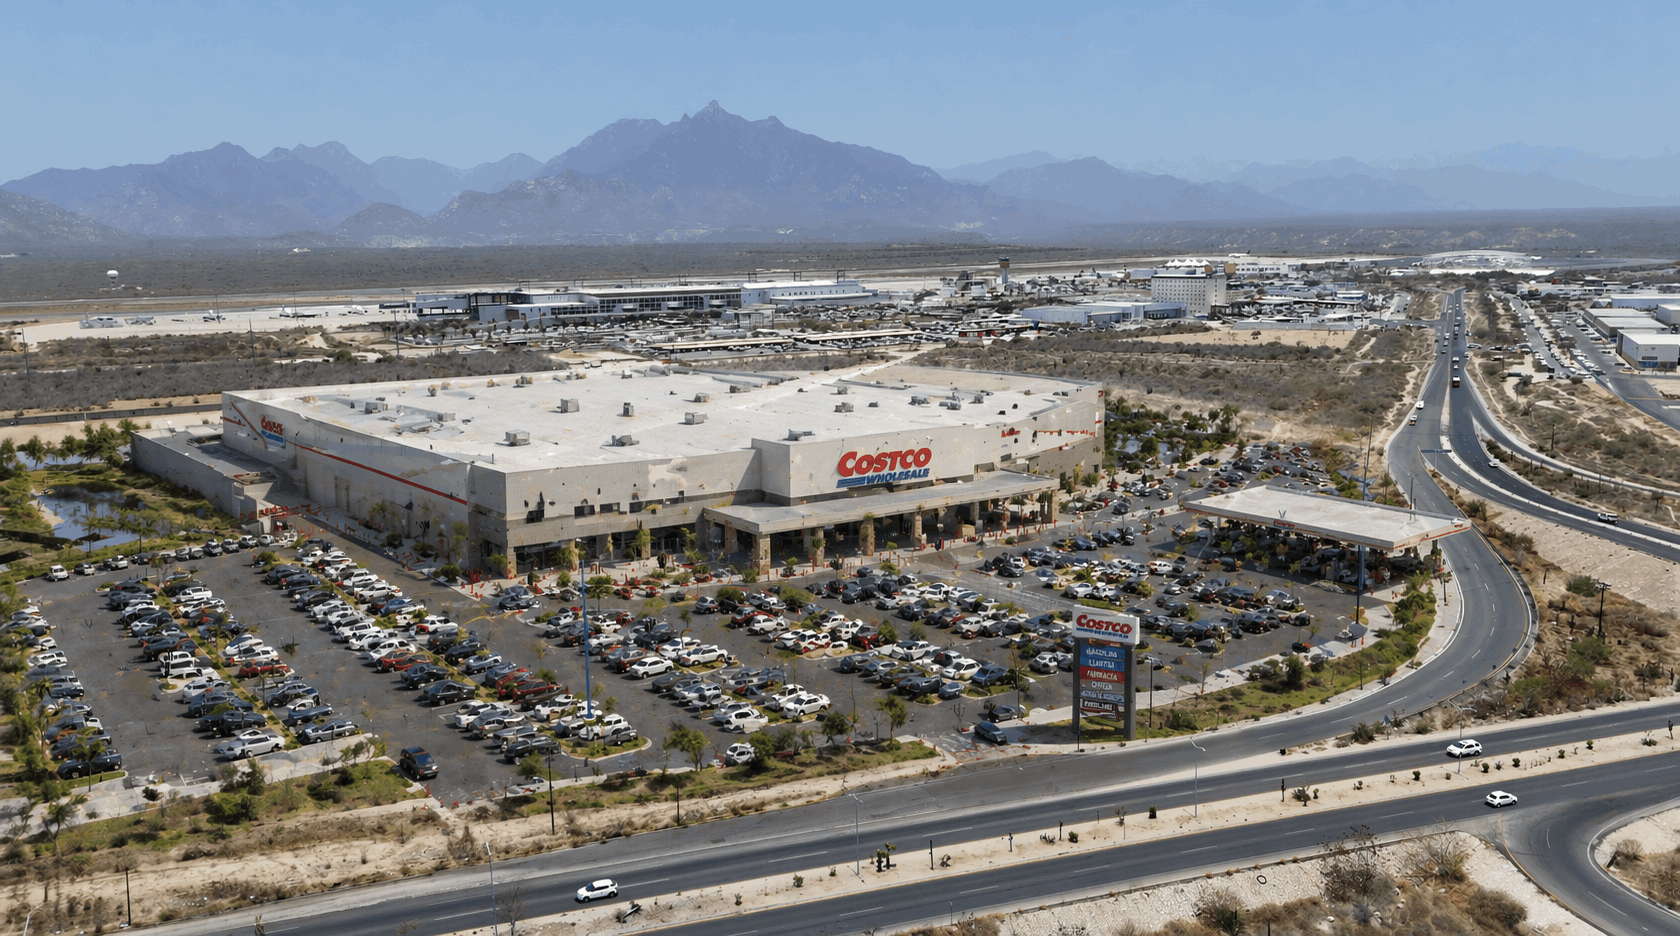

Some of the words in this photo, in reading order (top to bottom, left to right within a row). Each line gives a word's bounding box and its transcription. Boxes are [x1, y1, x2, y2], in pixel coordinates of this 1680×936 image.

[837, 447, 932, 477] COSTCO
[866, 468, 930, 485] WHOLESALE
[1076, 614, 1133, 634] COSTCO
